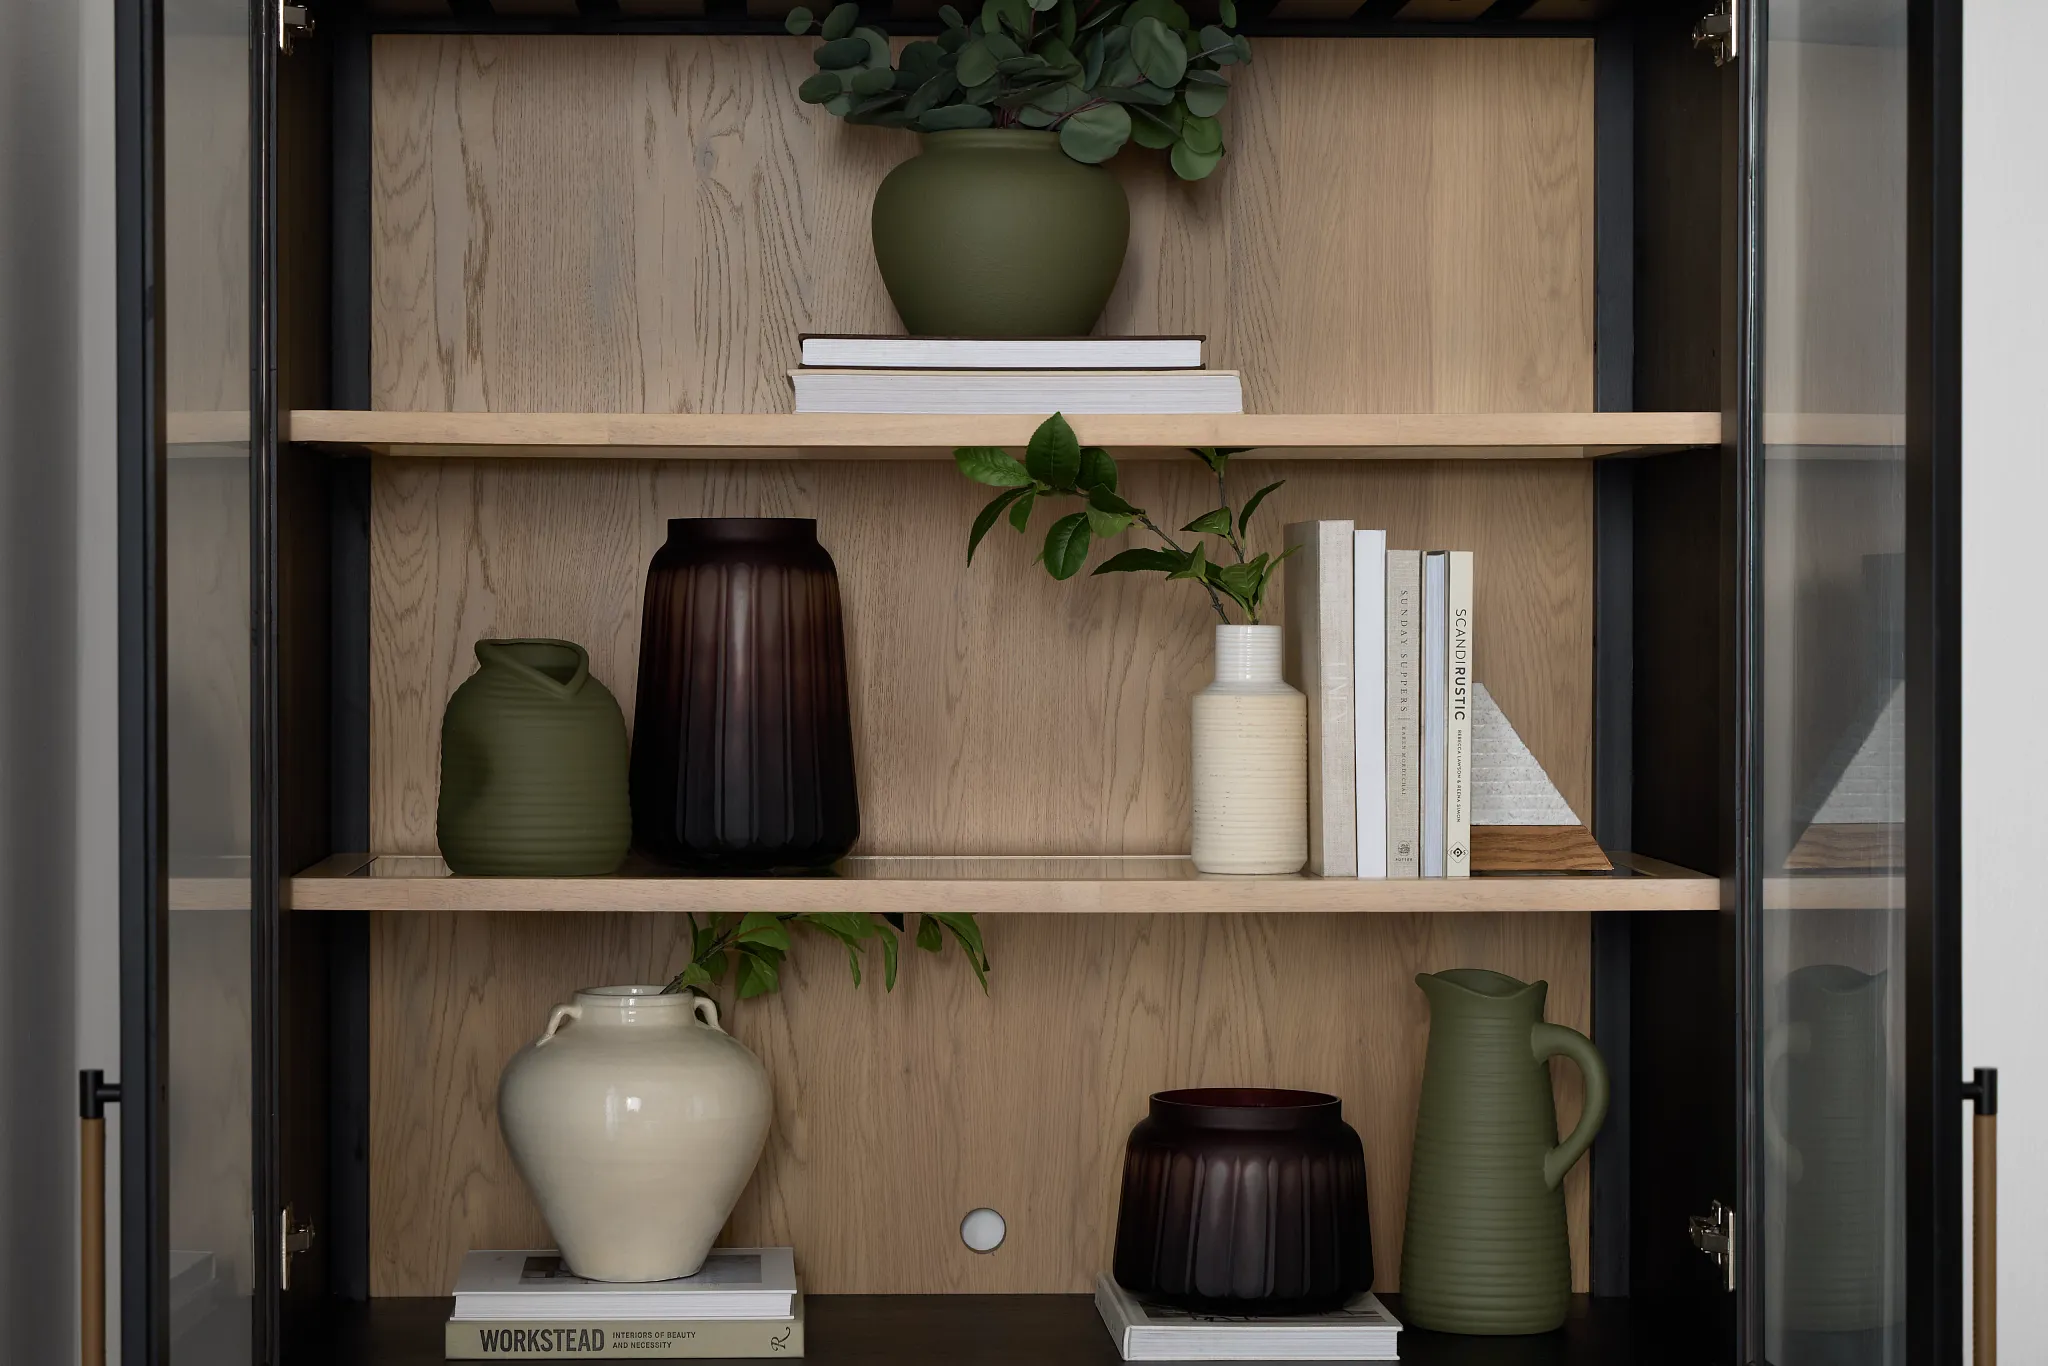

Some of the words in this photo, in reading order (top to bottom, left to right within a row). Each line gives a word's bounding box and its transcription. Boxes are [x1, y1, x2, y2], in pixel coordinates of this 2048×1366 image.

[1400, 590, 1408, 647] SUNDAY
[1400, 653, 1408, 713] SUPPERS
[1455, 609, 1467, 720] SCANDIRUSTIC
[480, 1329, 605, 1352] WORKSTEAD
[612, 1331, 654, 1340] INTERIORS
[655, 1331, 666, 1339] OF
[666, 1331, 697, 1339] BEAUTY
[612, 1341, 630, 1349] AND
[631, 1341, 673, 1349] NECESSITY
